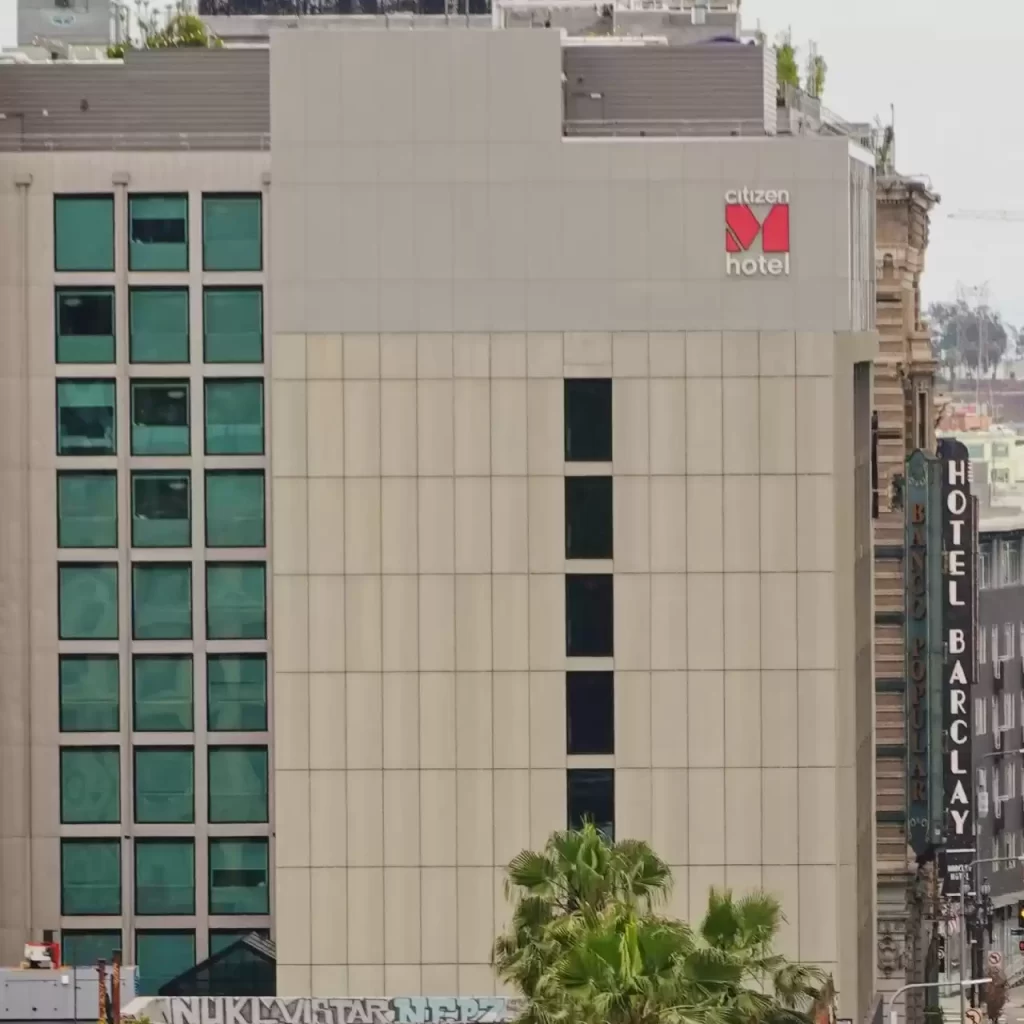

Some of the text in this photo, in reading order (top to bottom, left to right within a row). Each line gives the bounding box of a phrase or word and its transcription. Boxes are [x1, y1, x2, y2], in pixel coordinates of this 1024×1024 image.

[724, 185, 790, 204] citizen
[726, 252, 790, 275] hotel
[947, 459, 969, 835] HOTEL BARCLAY
